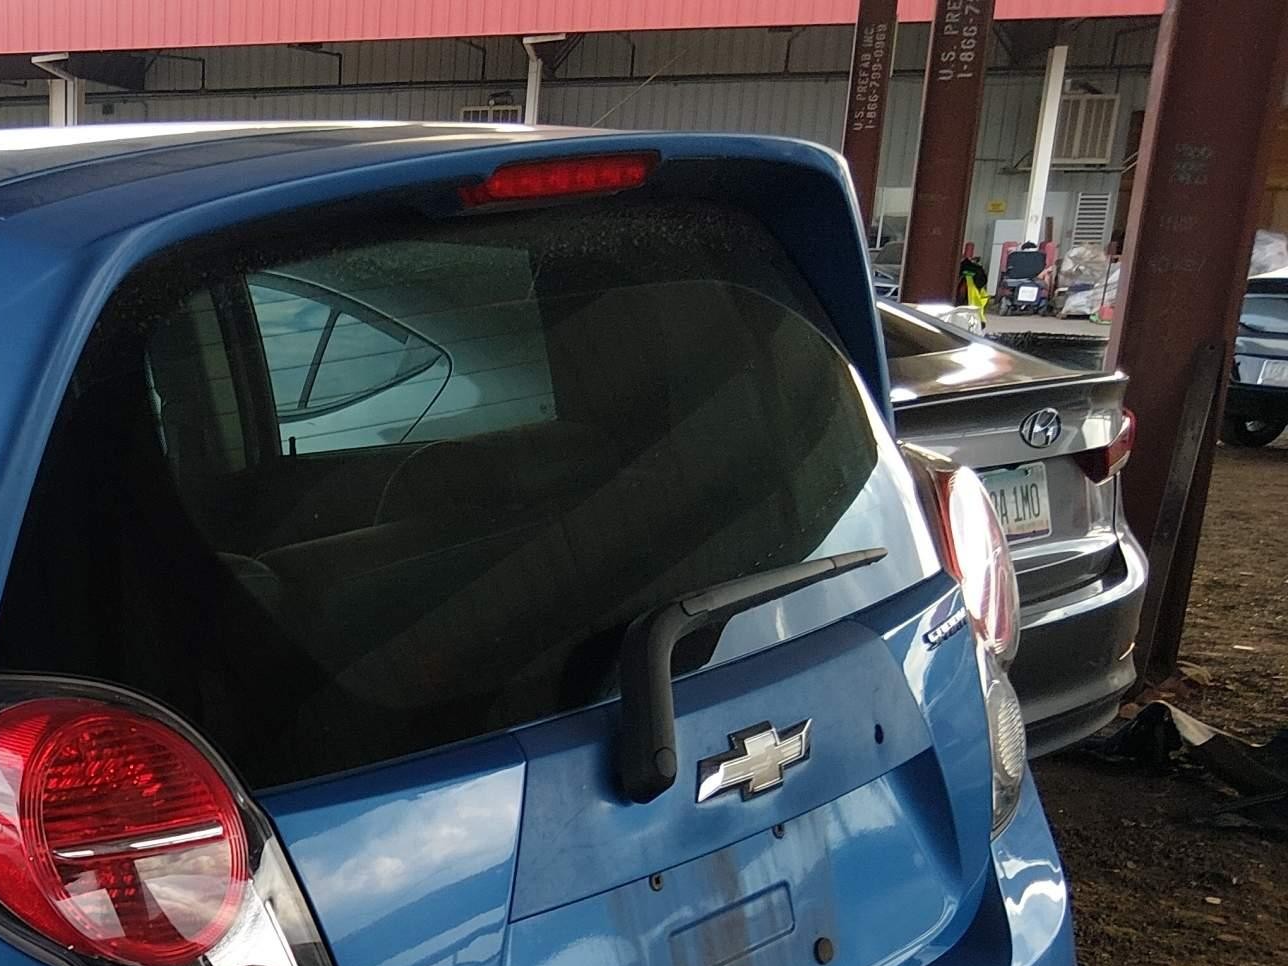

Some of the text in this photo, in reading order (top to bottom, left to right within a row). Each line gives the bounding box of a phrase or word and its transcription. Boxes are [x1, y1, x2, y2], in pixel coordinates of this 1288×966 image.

[957, 0, 980, 79] 1-866-7
[856, 53, 871, 101] PREFAB
[938, 45, 957, 81] U.S.
[853, 107, 865, 130] U.S.
